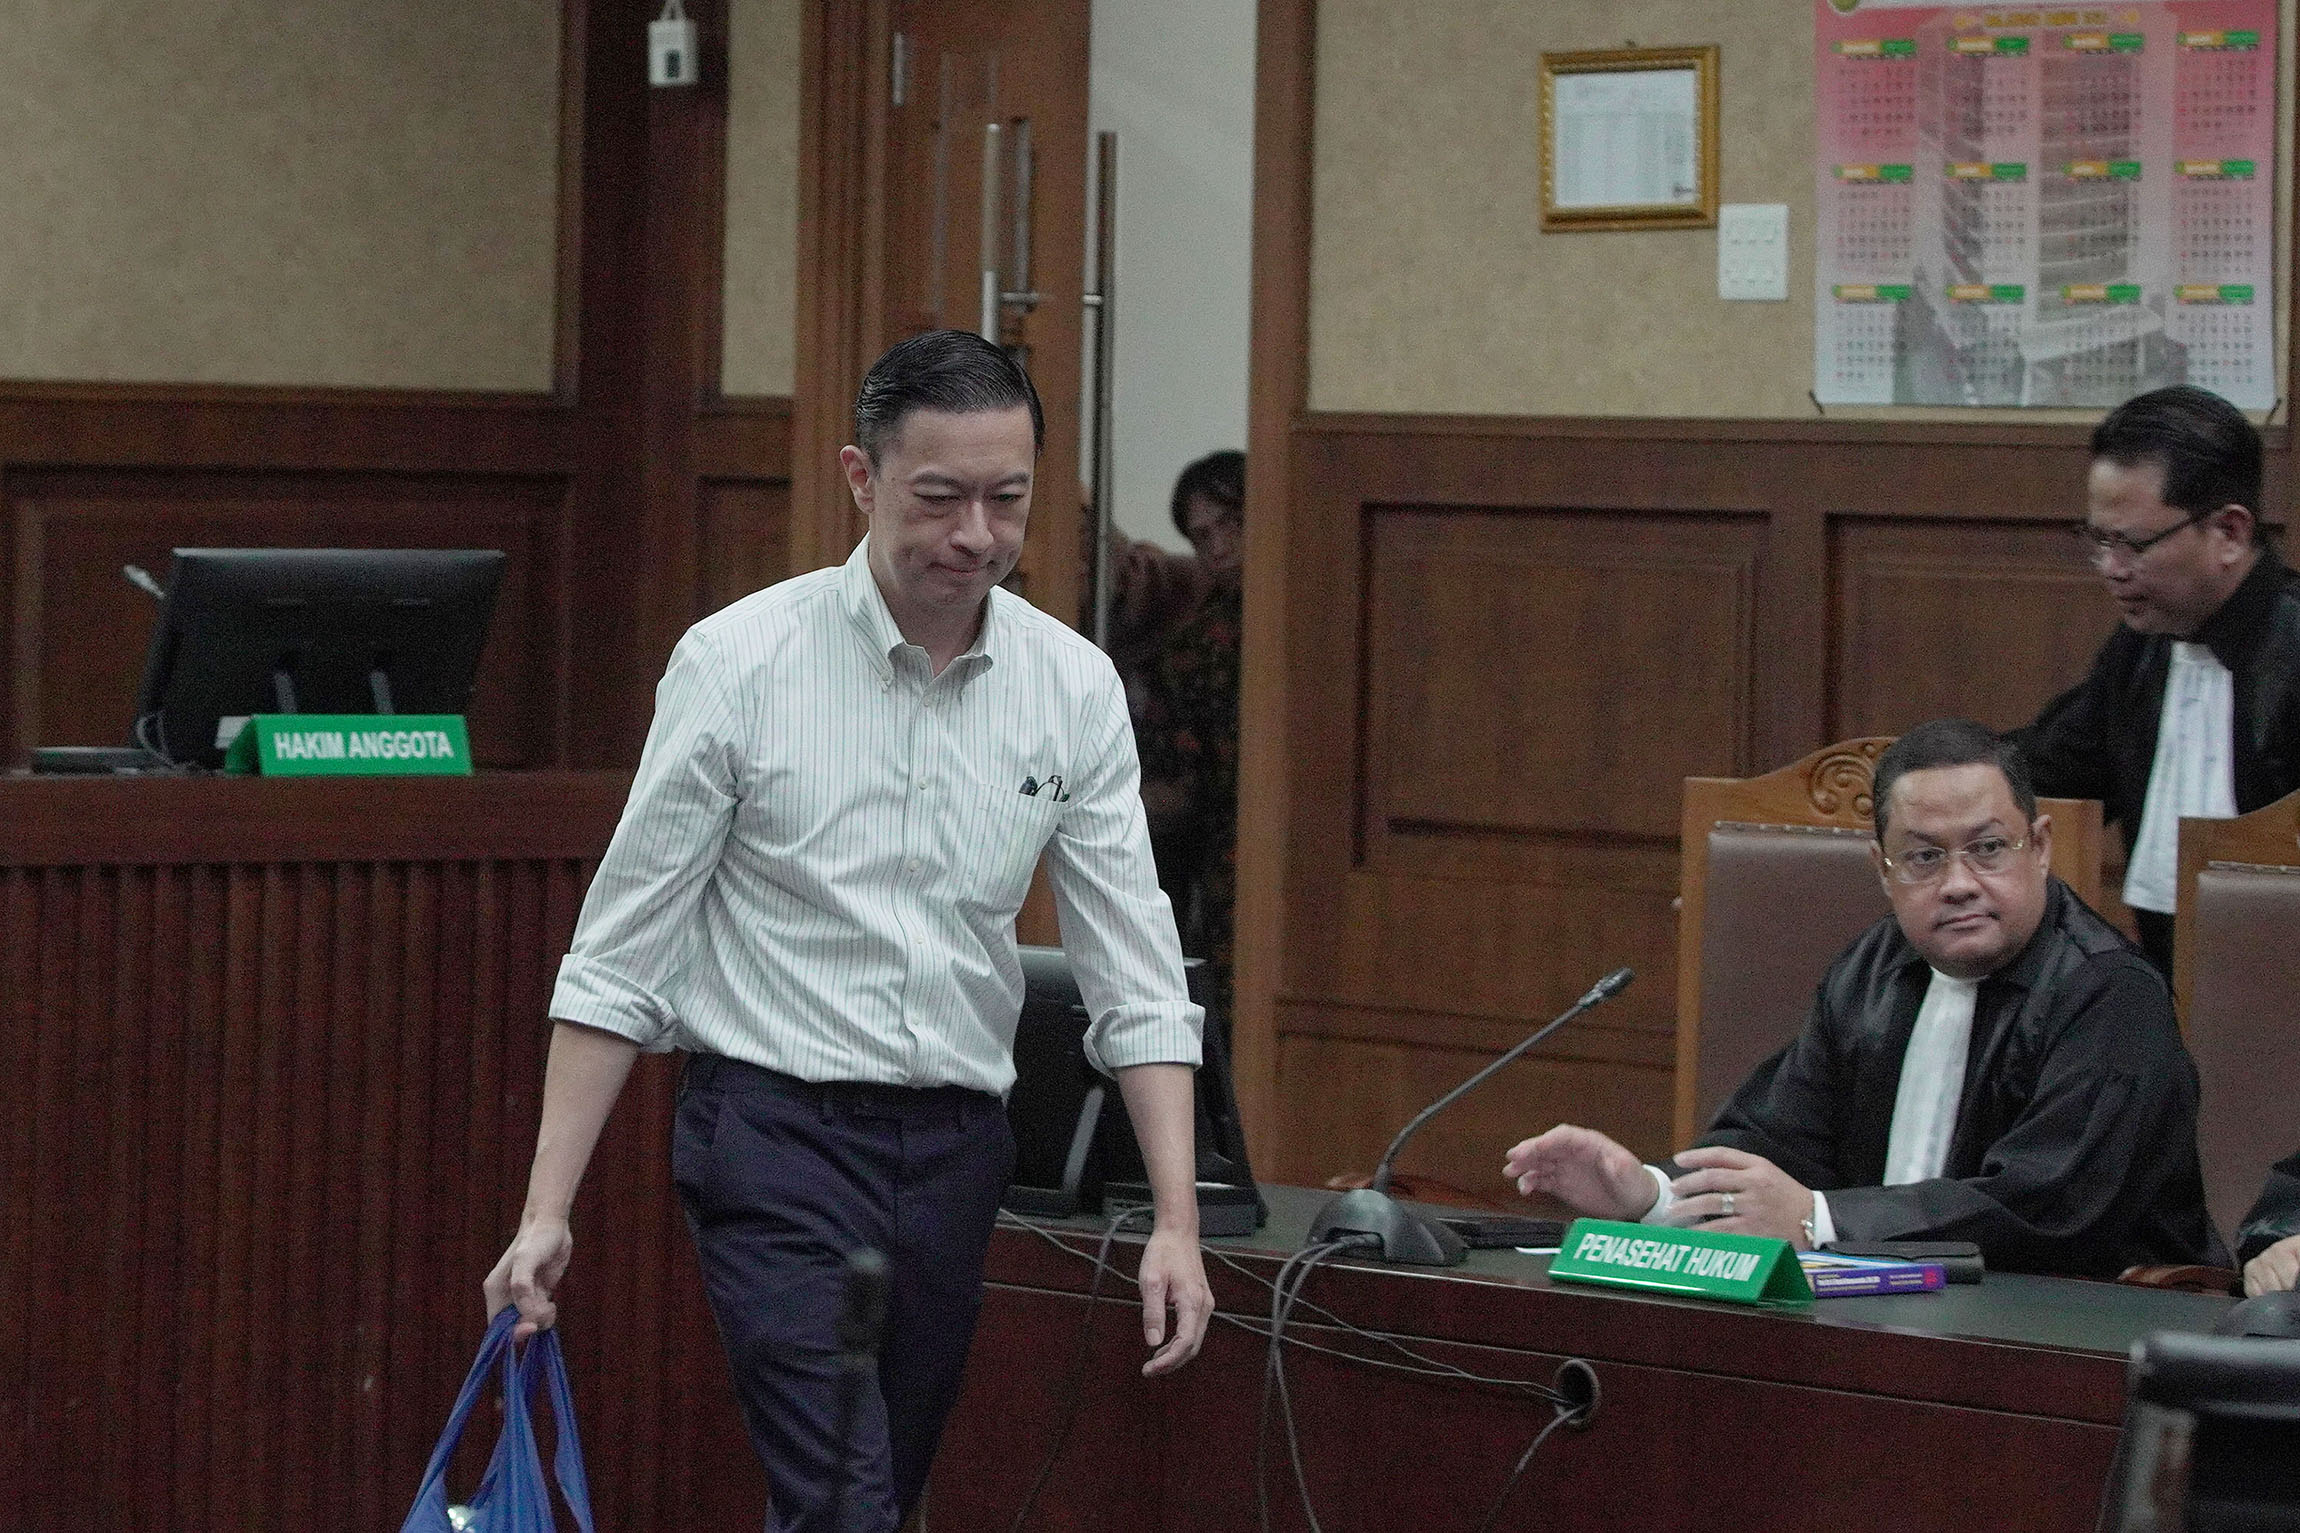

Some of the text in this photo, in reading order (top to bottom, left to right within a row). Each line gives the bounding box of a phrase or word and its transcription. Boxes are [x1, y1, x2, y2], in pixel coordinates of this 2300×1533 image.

[274, 731, 454, 759] HAKIM ANGGOTA
[1573, 1232, 1760, 1281] PENASEHAT HUKUM
